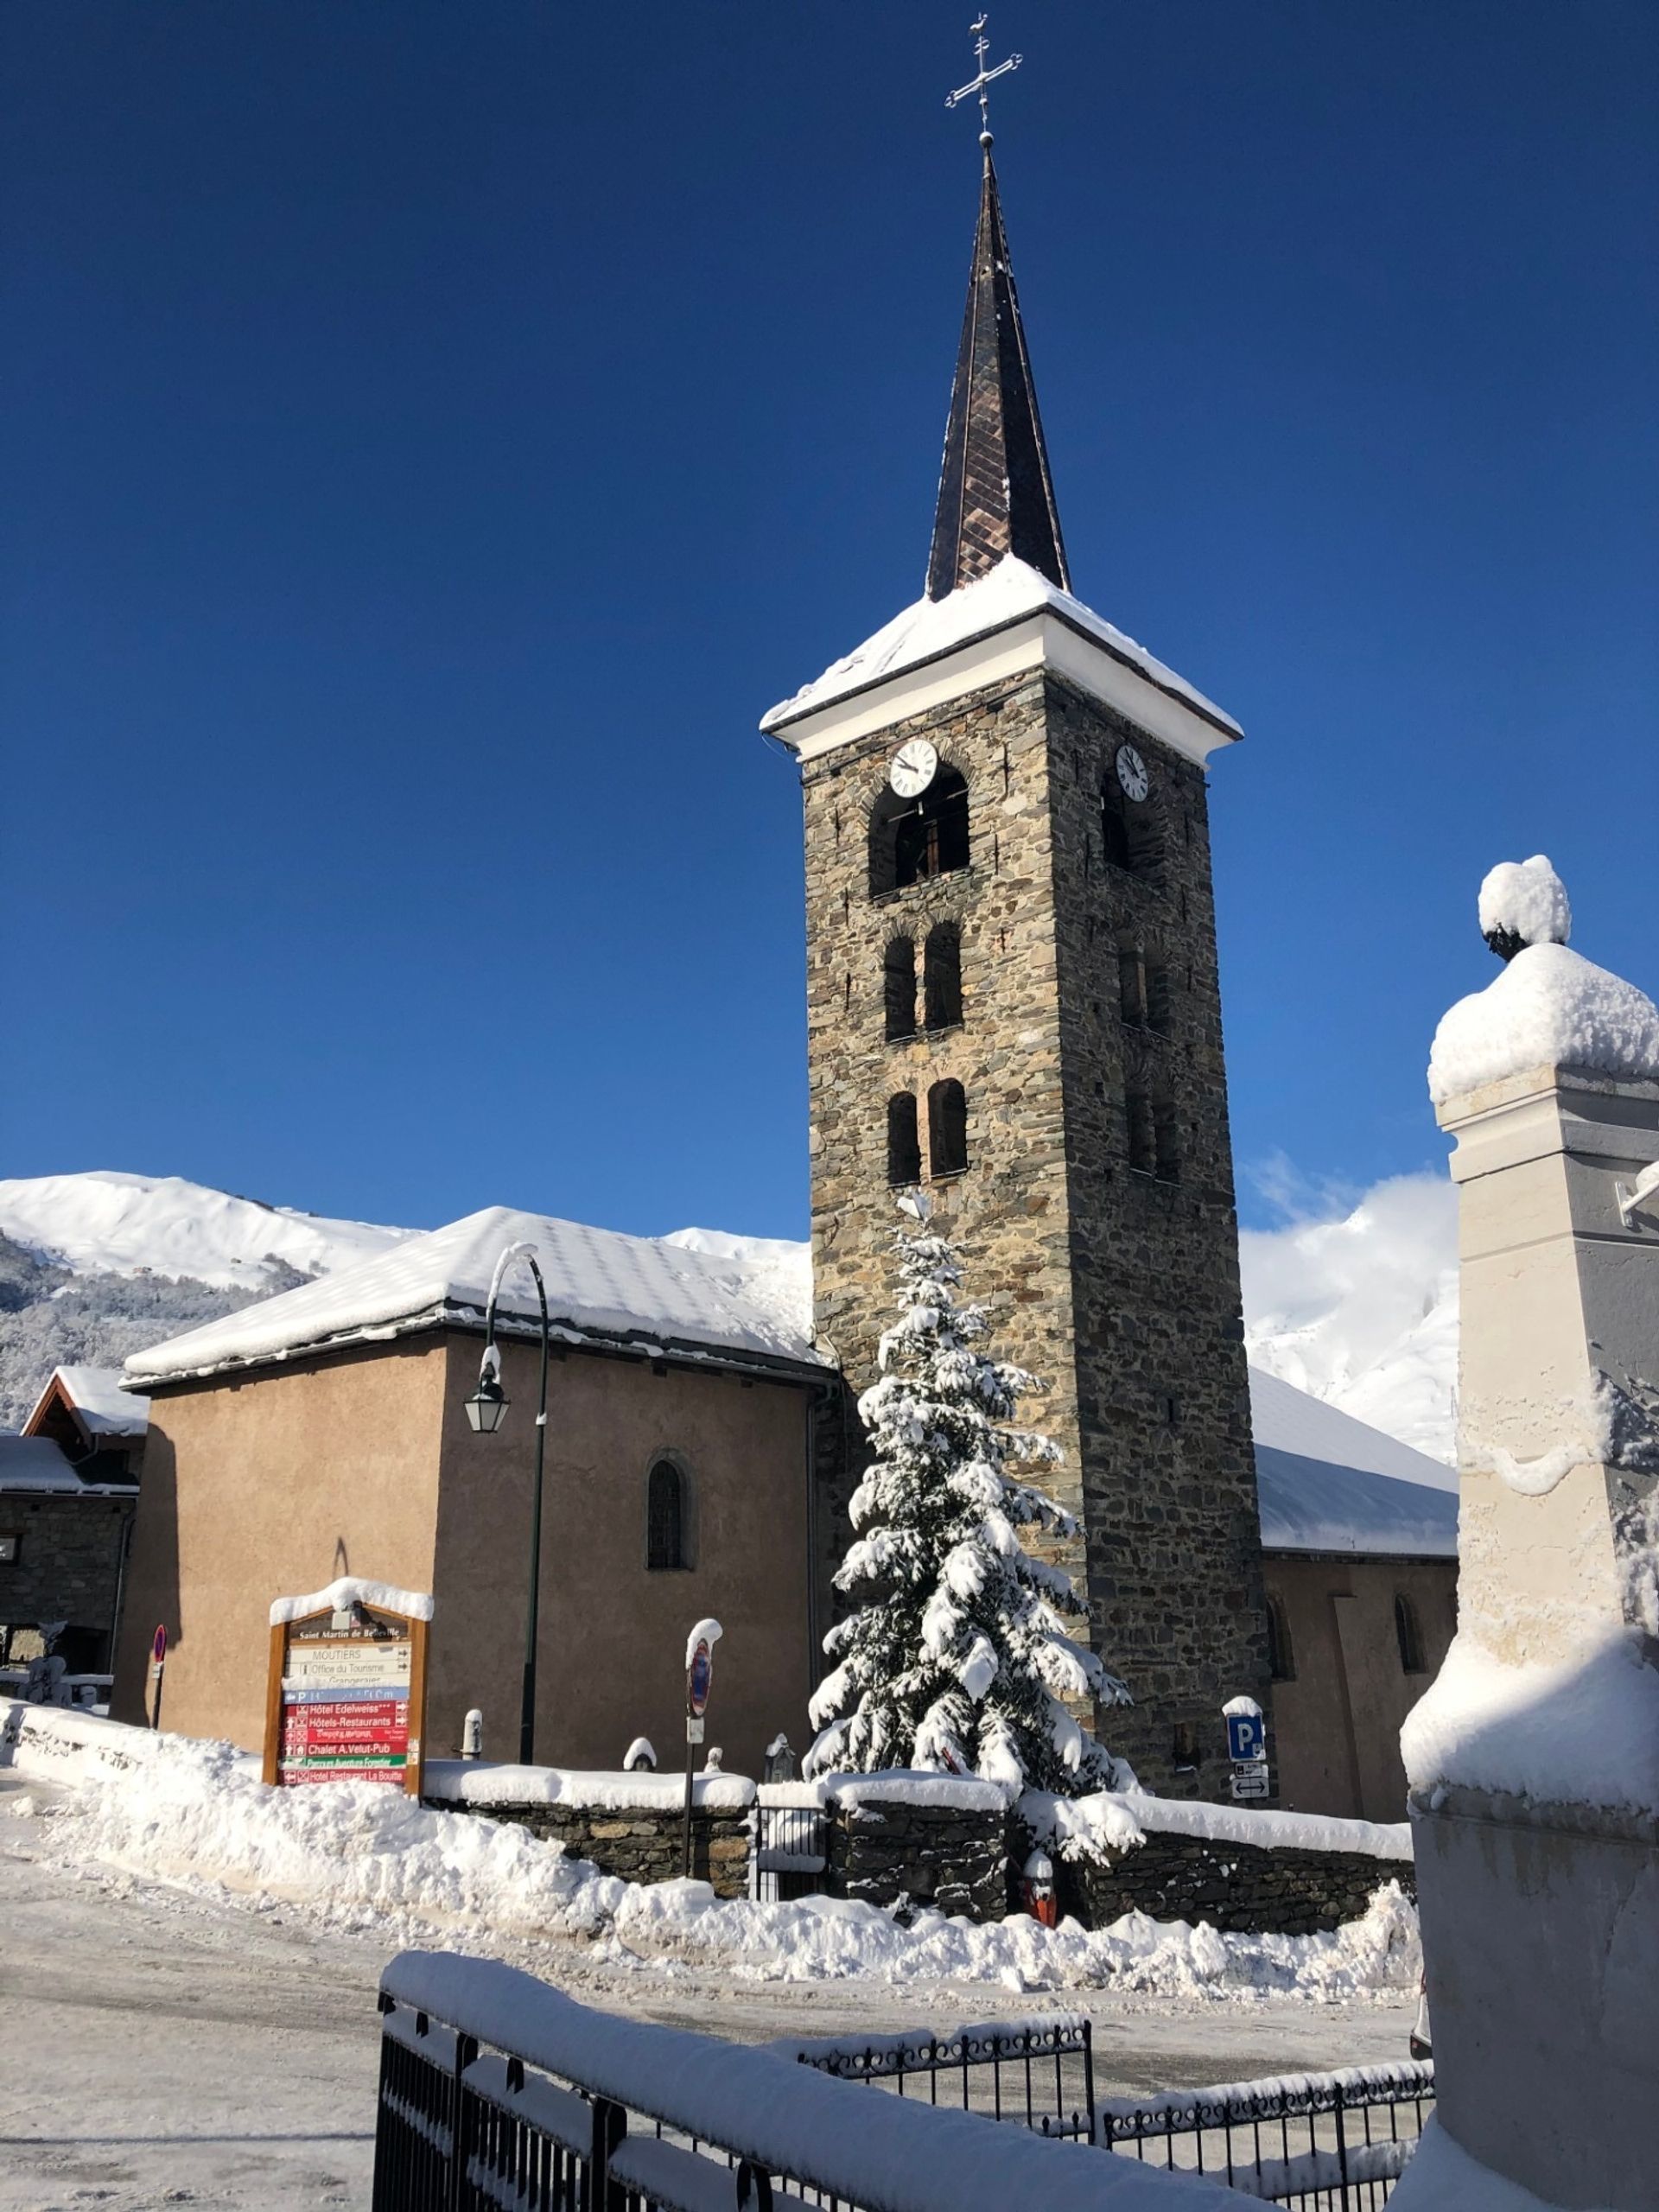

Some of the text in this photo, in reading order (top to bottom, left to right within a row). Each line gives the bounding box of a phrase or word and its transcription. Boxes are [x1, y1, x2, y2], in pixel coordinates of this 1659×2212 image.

[300, 1631, 319, 1640] Saint
[321, 1630, 349, 1639] Martin
[352, 1630, 361, 1638] de
[313, 1649, 361, 1660] MOUTIERS
[311, 1665, 334, 1675] Office
[337, 1664, 346, 1674] du
[350, 1663, 385, 1673] Tourisme
[298, 1692, 306, 1702] P
[309, 1704, 334, 1714] Hôtel
[308, 1717, 391, 1727] Hôtels-Restaurants
[1237, 1723, 1254, 1751] P
[308, 1744, 337, 1755] Chalet
[368, 1770, 378, 1781] La
